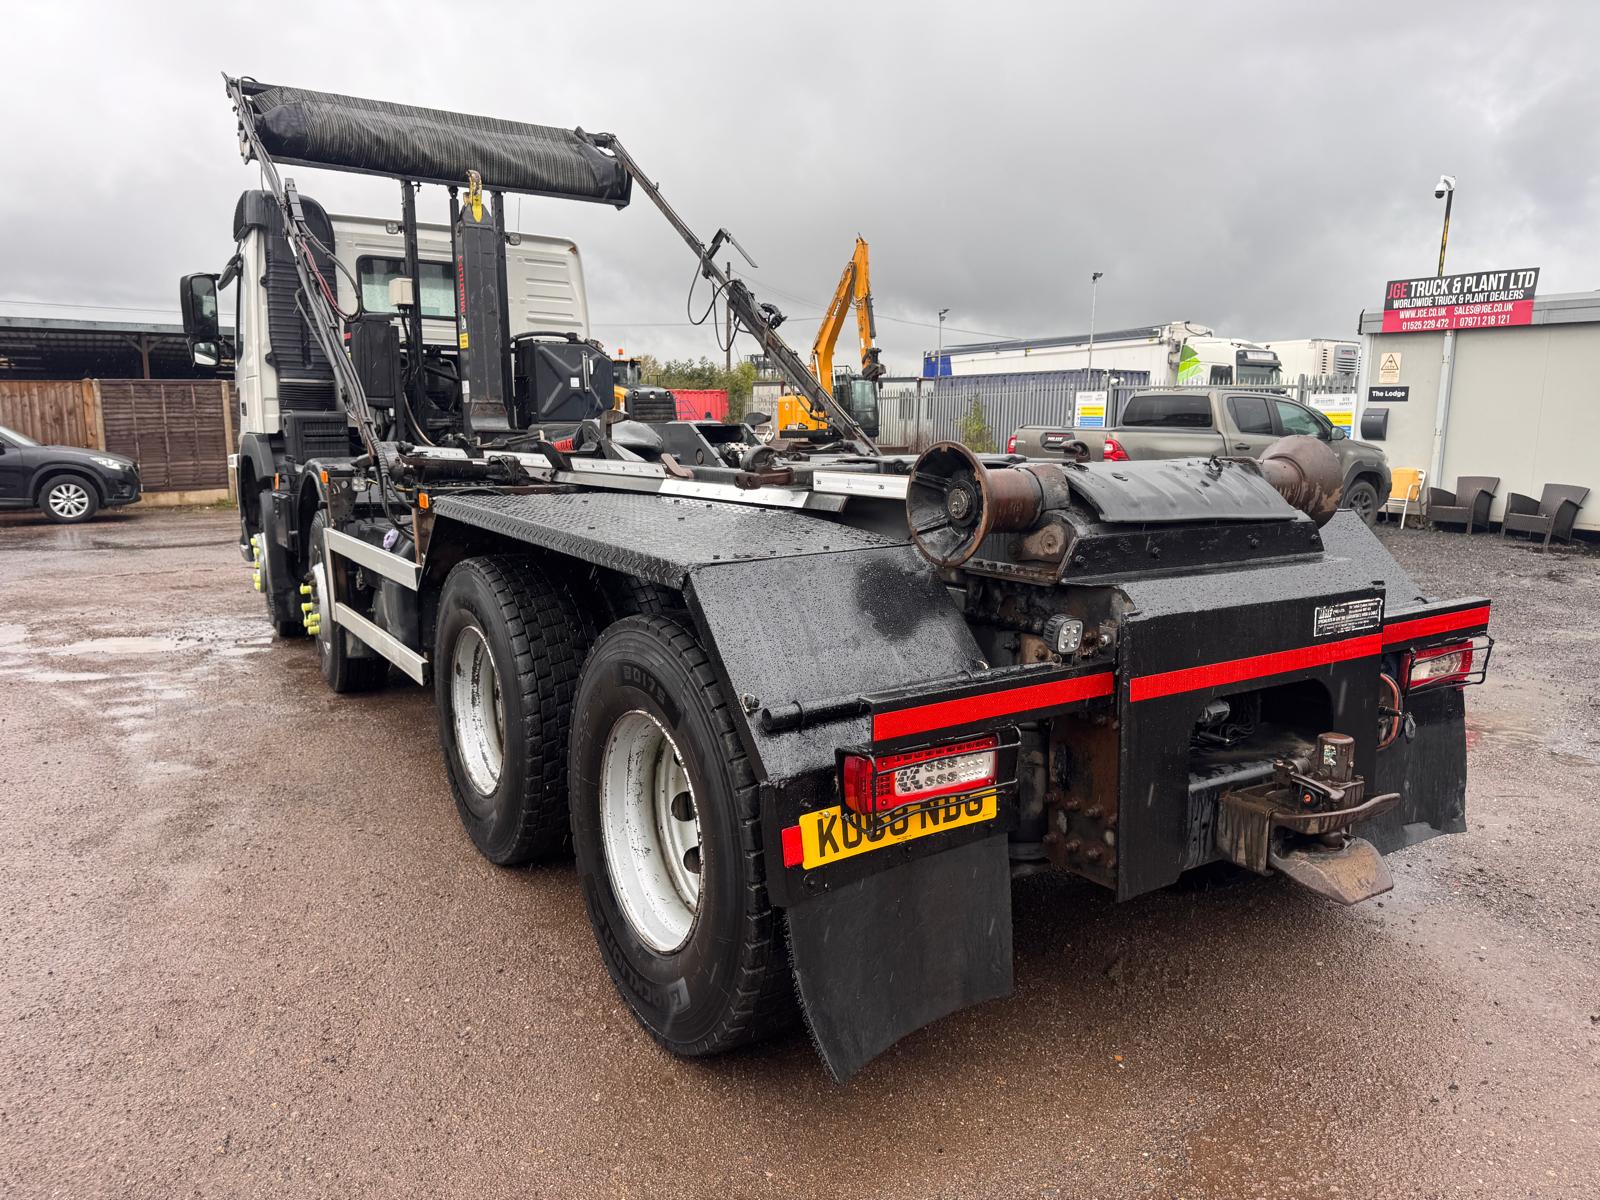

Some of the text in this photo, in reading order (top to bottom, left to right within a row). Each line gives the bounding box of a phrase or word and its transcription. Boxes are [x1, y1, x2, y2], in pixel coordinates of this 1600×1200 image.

[1387, 271, 1536, 299] JGE TRUCK & PLANT LTD
[1393, 289, 1524, 309] WORLDWIDE TRUCK & PLANT DEALERS
[1436, 318, 1449, 328] 472
[1459, 316, 1481, 327] 07971
[1497, 314, 1511, 324] 121
[1385, 390, 1405, 398] Lodge
